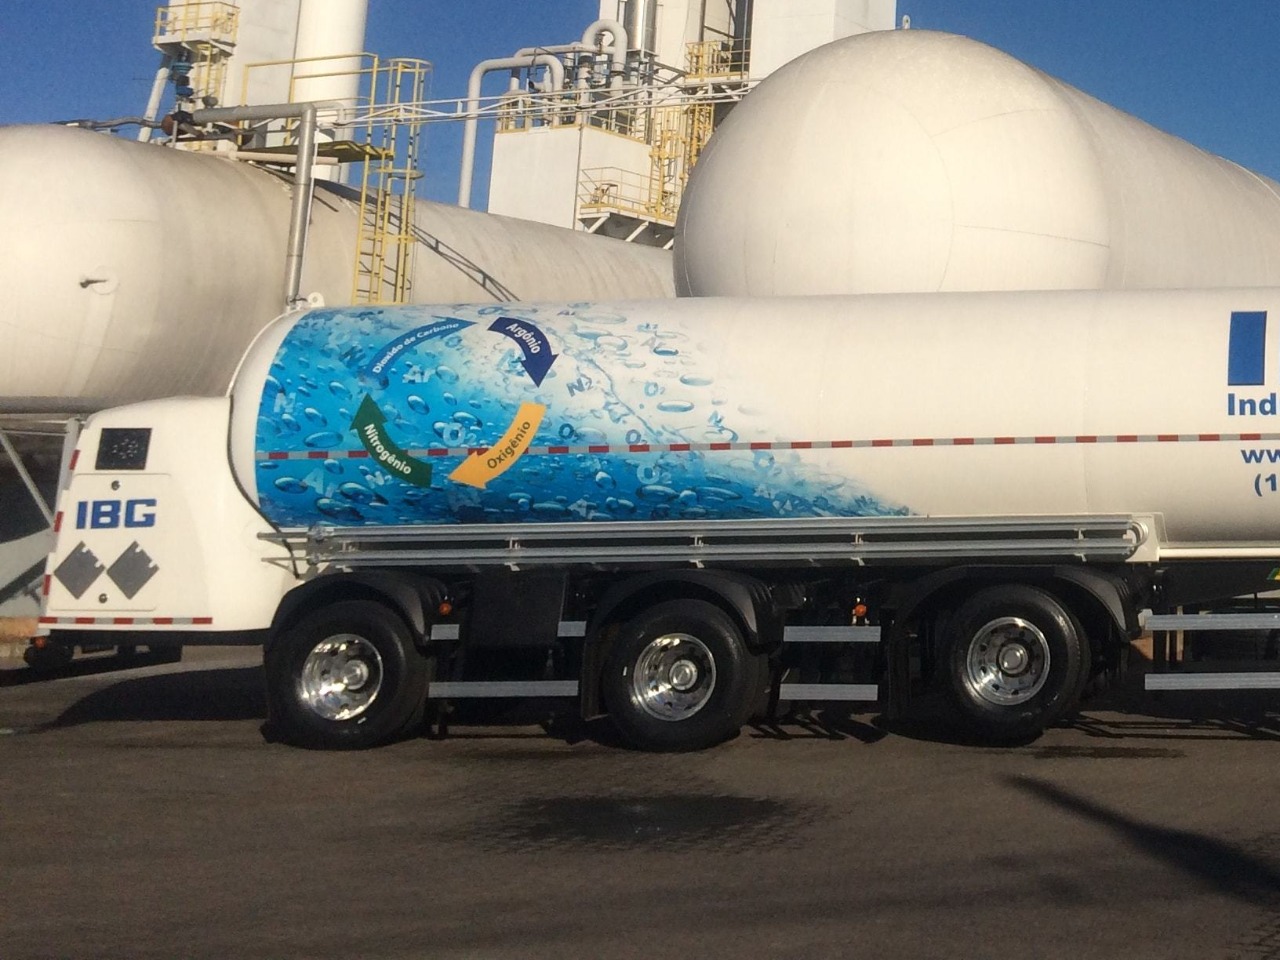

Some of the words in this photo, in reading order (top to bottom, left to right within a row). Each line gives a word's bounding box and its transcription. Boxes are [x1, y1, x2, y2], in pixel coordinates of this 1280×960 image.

[416, 322, 460, 339] Carbono
[505, 323, 542, 354] Argônio
[364, 423, 412, 475] Nitrogênio
[487, 420, 531, 470] Oxigênio
[76, 499, 157, 529] IBG
